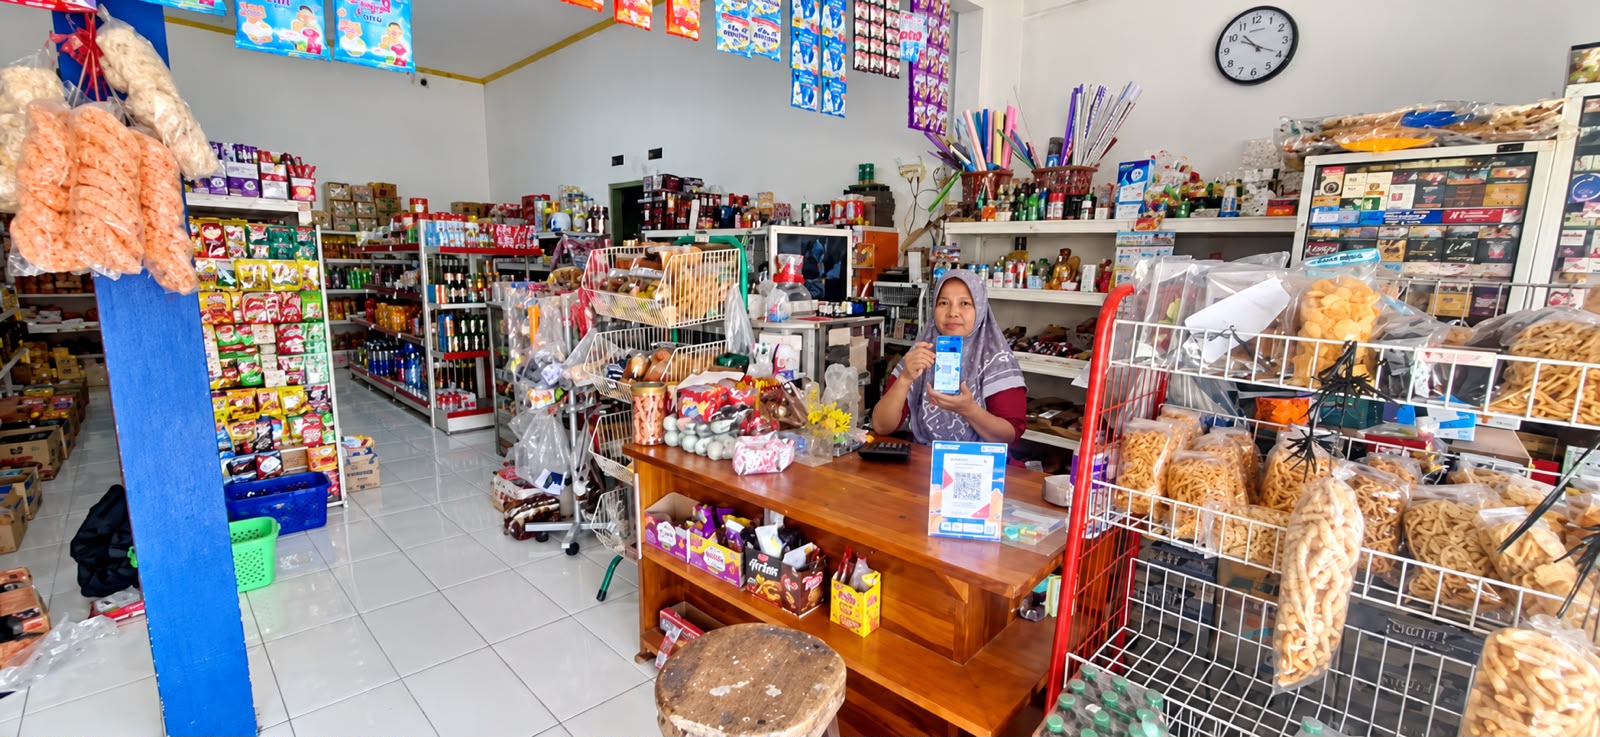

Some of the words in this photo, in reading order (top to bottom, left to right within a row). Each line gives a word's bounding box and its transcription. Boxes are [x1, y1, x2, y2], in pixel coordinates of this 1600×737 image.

[1252, 15, 1262, 24] 12
[1269, 16, 1273, 25] 1
[1239, 23, 1247, 31] 11
[1277, 23, 1285, 32] 2
[1229, 33, 1238, 43] 10
[1281, 35, 1289, 44] 3
[1223, 47, 1230, 56] 9
[1275, 50, 1282, 58] 4
[1227, 59, 1234, 68] 8
[1265, 61, 1272, 70] 5
[1238, 66, 1244, 75] 7
[1250, 67, 1257, 76] 6
